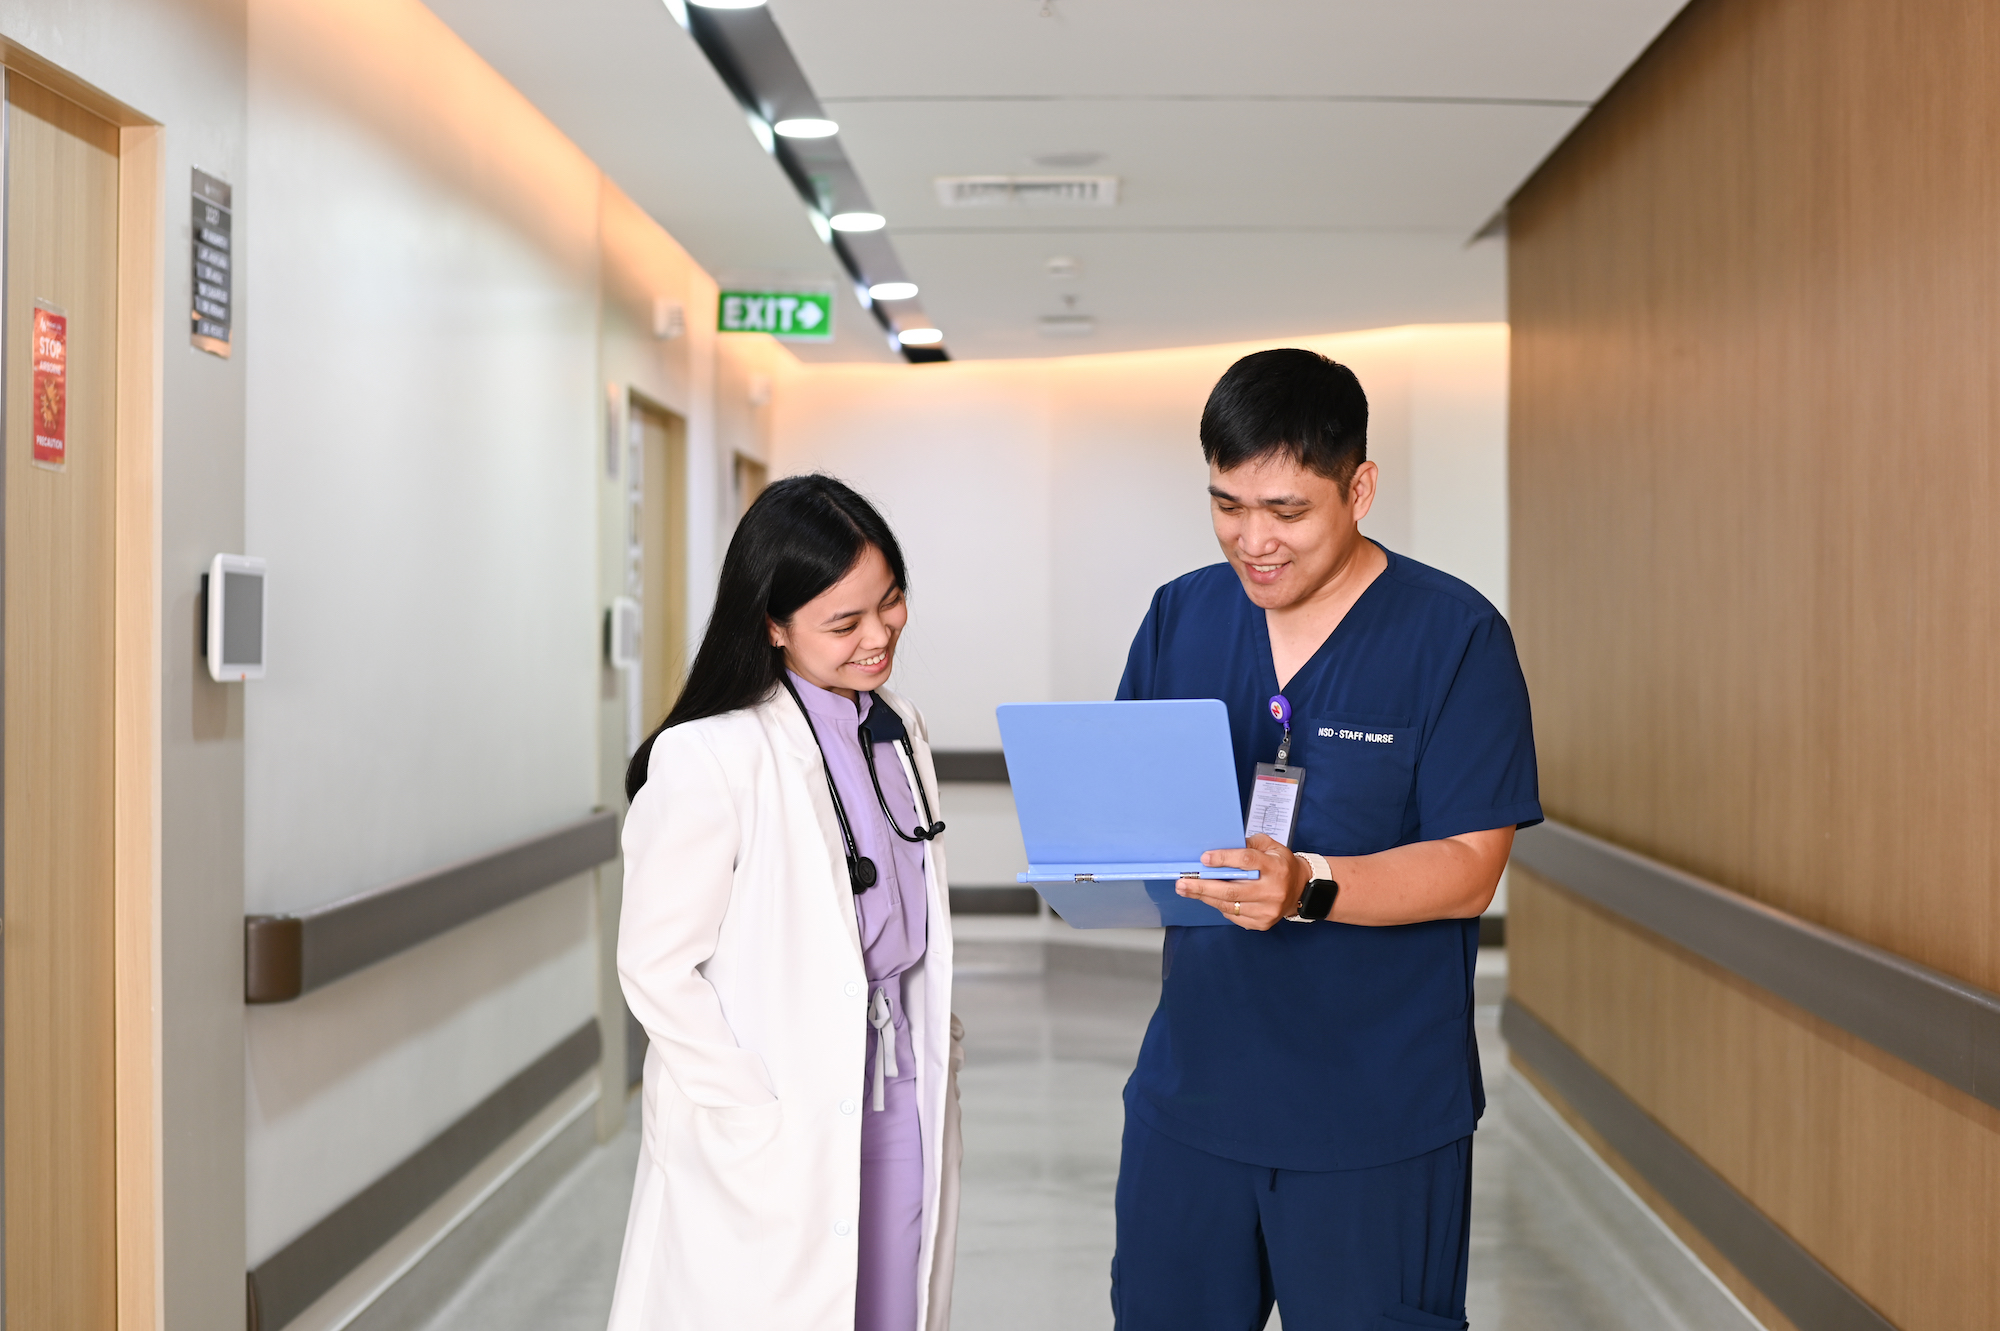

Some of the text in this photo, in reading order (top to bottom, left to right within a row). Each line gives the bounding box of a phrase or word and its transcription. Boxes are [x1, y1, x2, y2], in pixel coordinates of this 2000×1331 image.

[723, 297, 799, 332] EXIT
[39, 336, 62, 360] STOP
[39, 360, 62, 376] AIRBORNE
[36, 435, 63, 450] PRECAUTION
[1318, 727, 1334, 737] NSD
[1339, 729, 1364, 741] STAFF
[1365, 732, 1394, 743] NURSE
